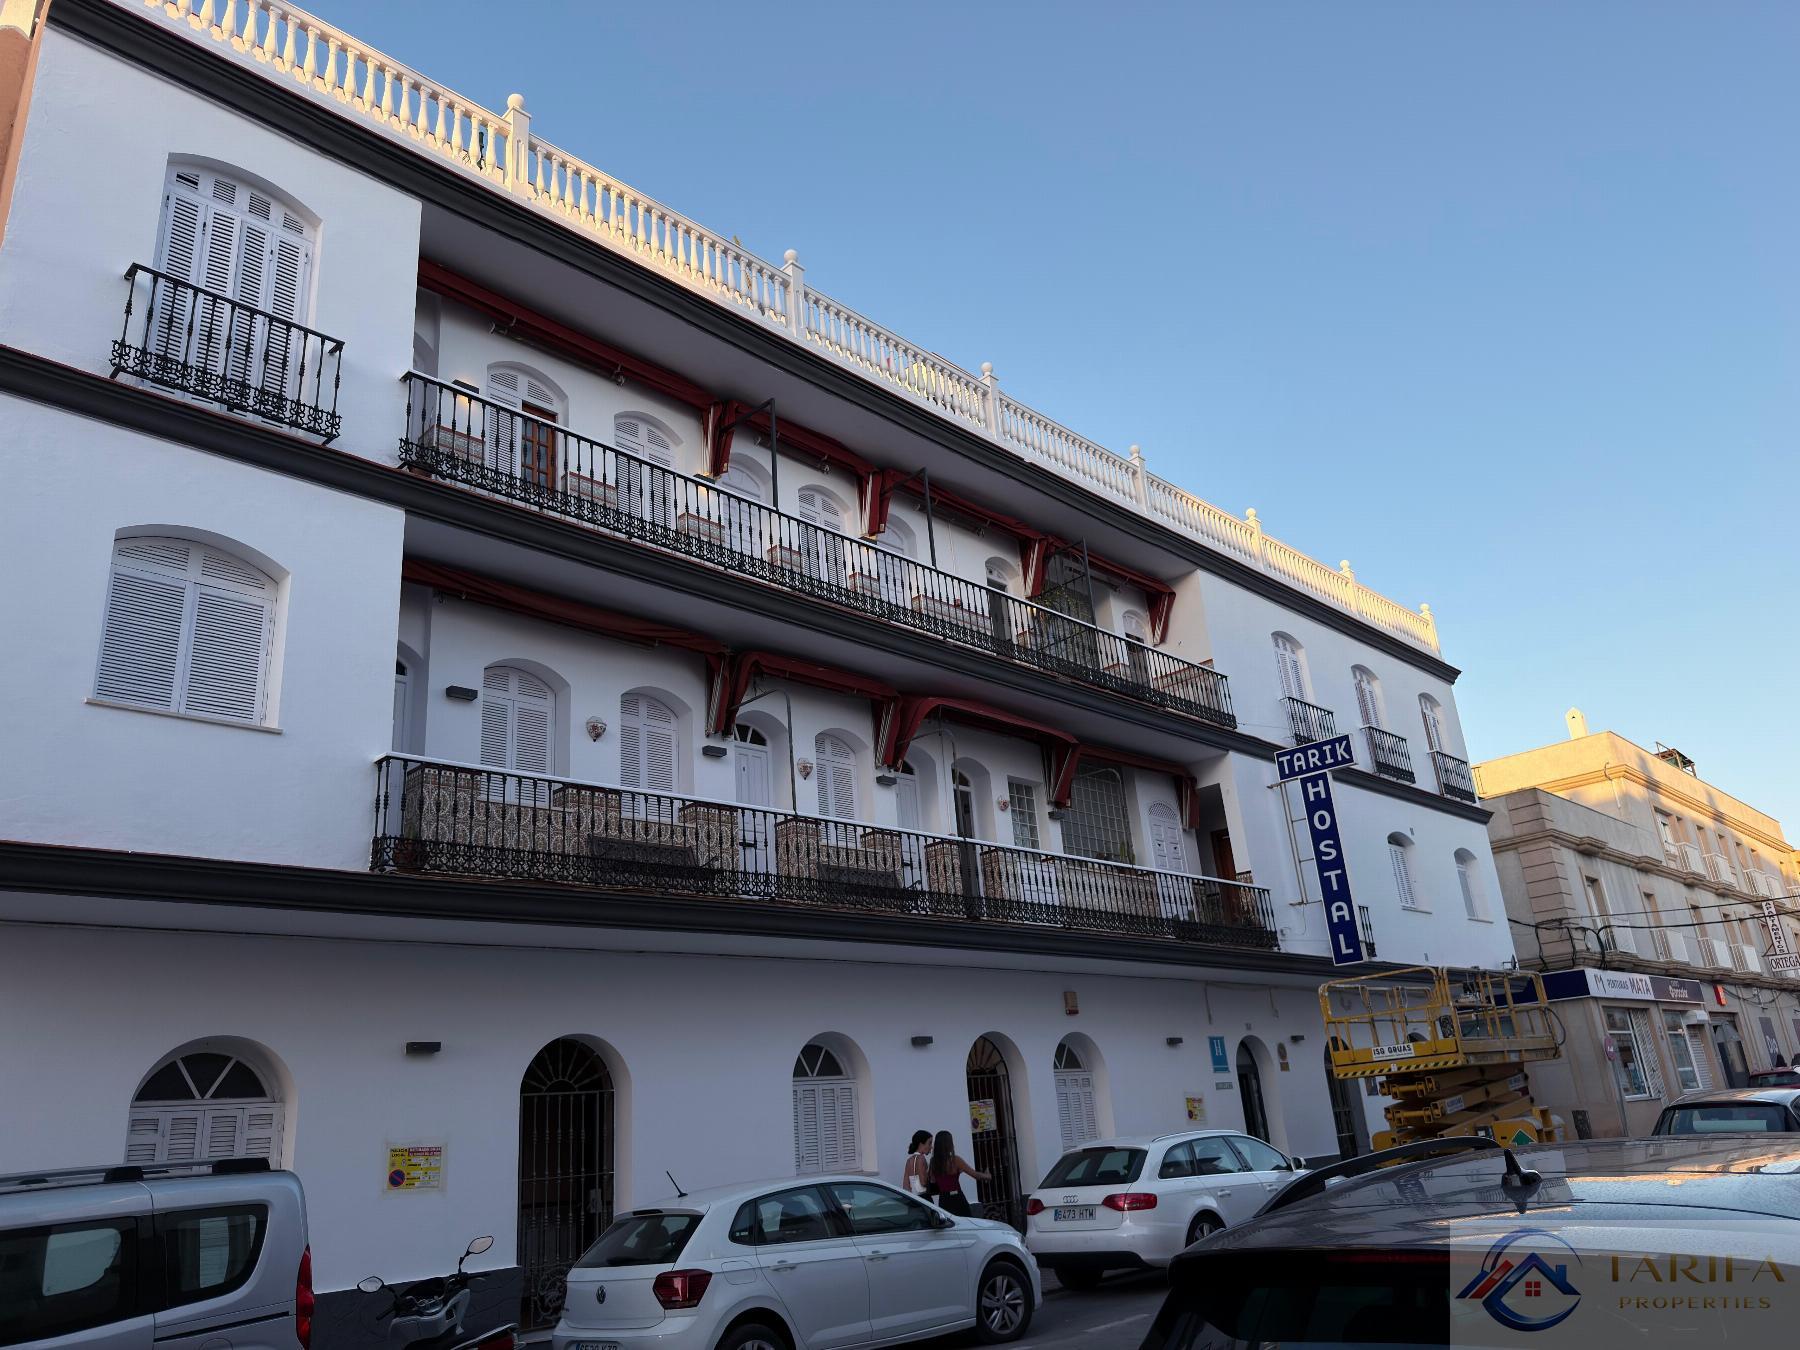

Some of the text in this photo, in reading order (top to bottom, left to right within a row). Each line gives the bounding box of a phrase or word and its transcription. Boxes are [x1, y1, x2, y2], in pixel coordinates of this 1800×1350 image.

[1278, 740, 1351, 775] TARIK
[1306, 779, 1354, 955] HOSTAL
[1771, 955, 1800, 970] ORTEGA
[1628, 977, 1653, 996] MATA
[1387, 1044, 1412, 1055] GRUAS
[1058, 1209, 1077, 1220] 6473
